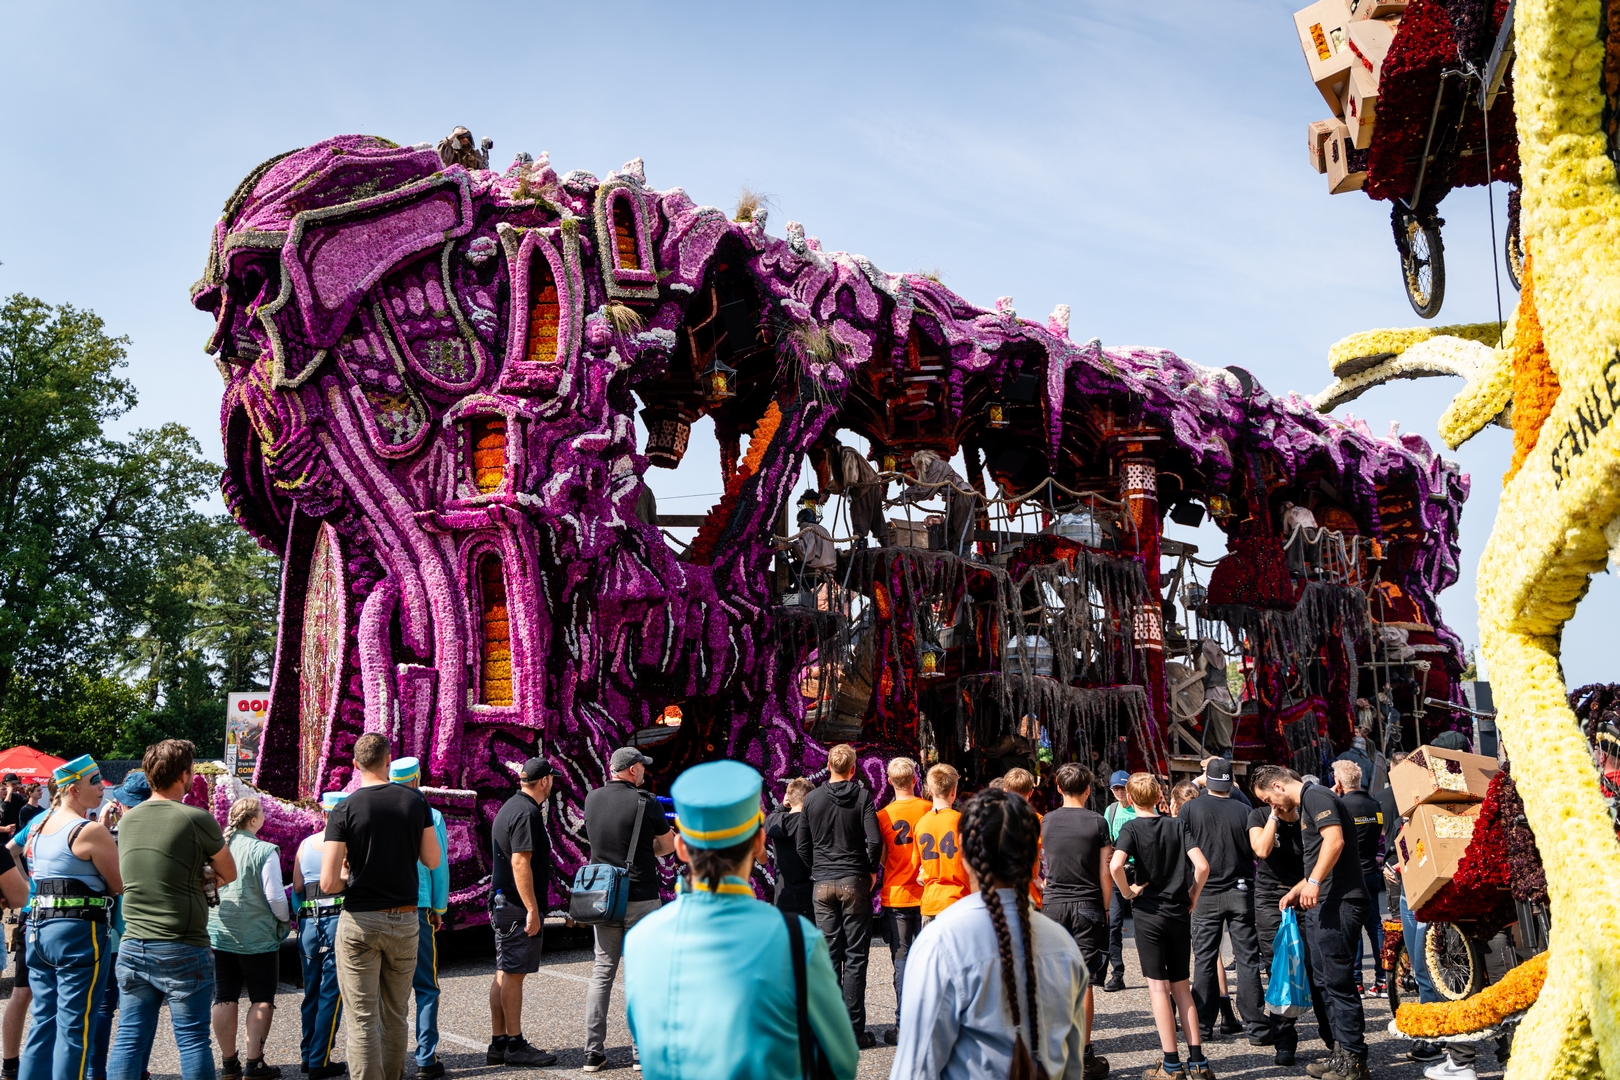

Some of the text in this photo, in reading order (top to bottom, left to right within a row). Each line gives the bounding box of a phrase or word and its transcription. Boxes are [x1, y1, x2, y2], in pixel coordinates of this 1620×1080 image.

[1551, 350, 1620, 491] STANLE
[892, 820, 913, 845] 2
[919, 831, 958, 860] 24
